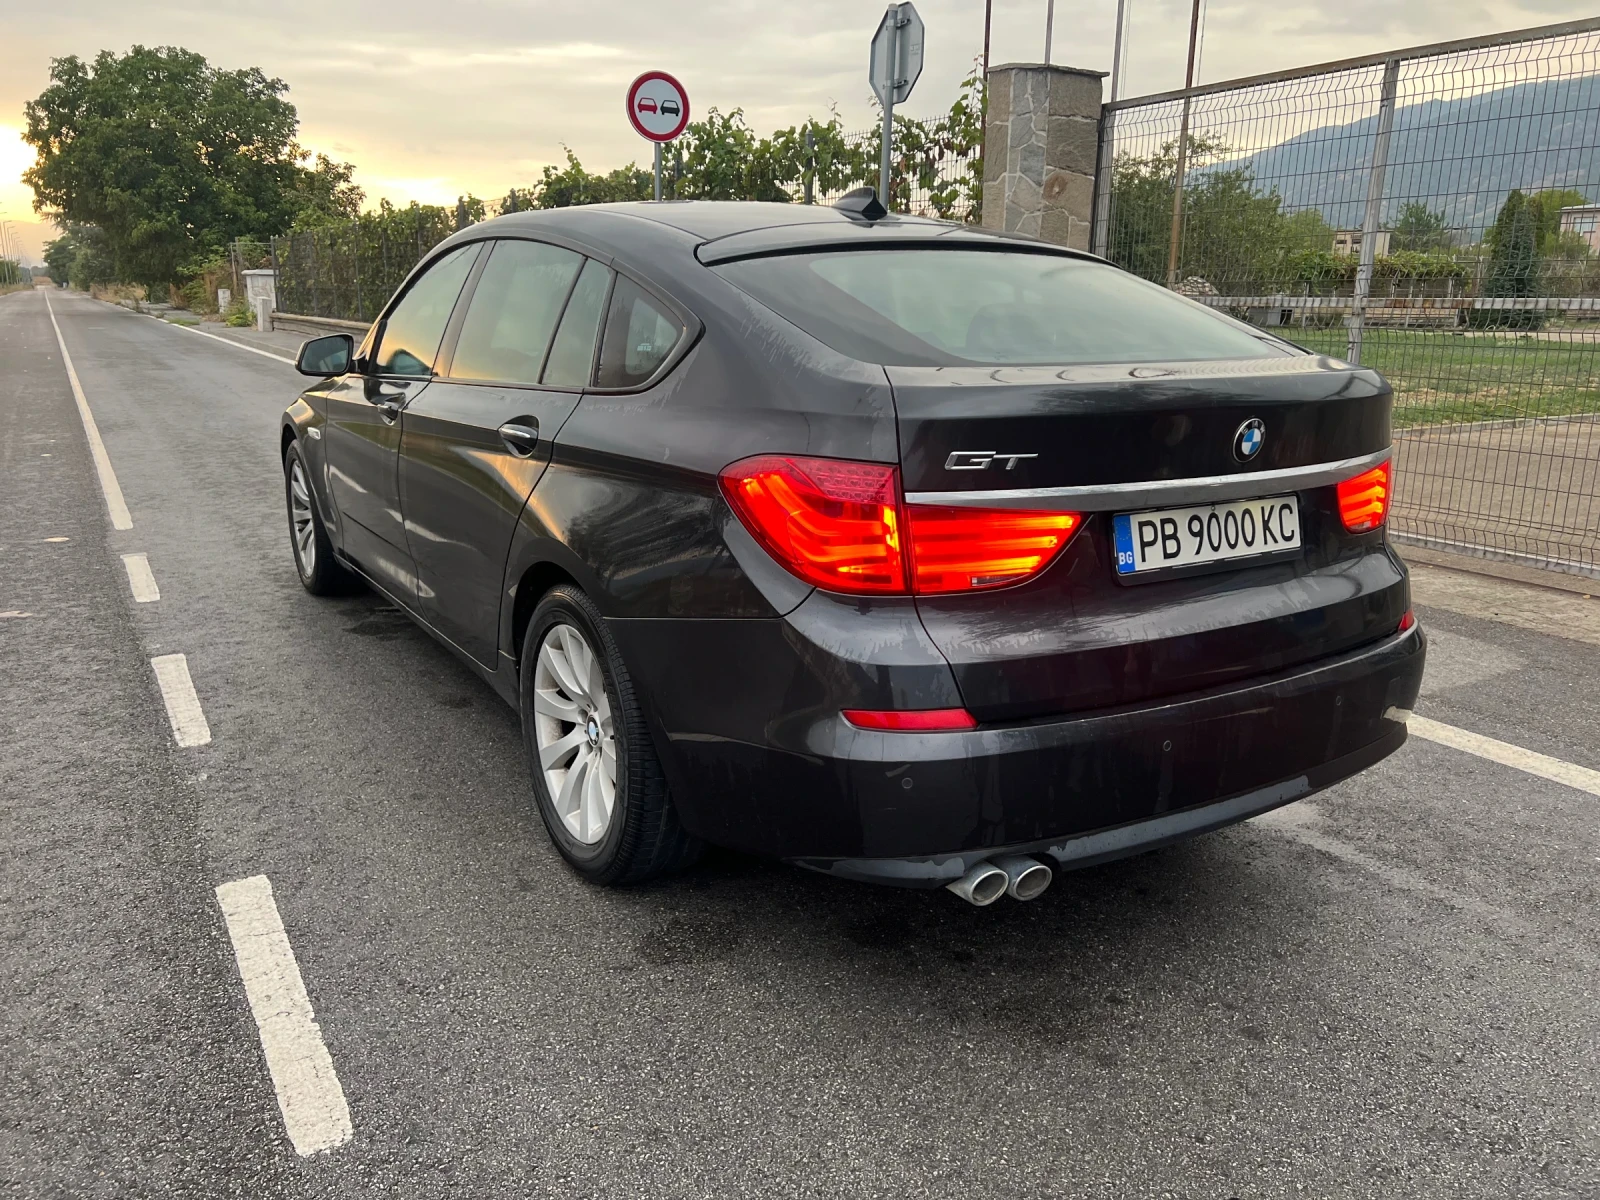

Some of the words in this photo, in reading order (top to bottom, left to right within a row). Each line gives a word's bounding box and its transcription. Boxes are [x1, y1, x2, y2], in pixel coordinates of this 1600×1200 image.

[944, 450, 1039, 471] GT
[1138, 517, 1182, 563] PB
[1187, 507, 1256, 556] 9000
[1260, 503, 1295, 545] KC
[1118, 552, 1133, 565] BG
